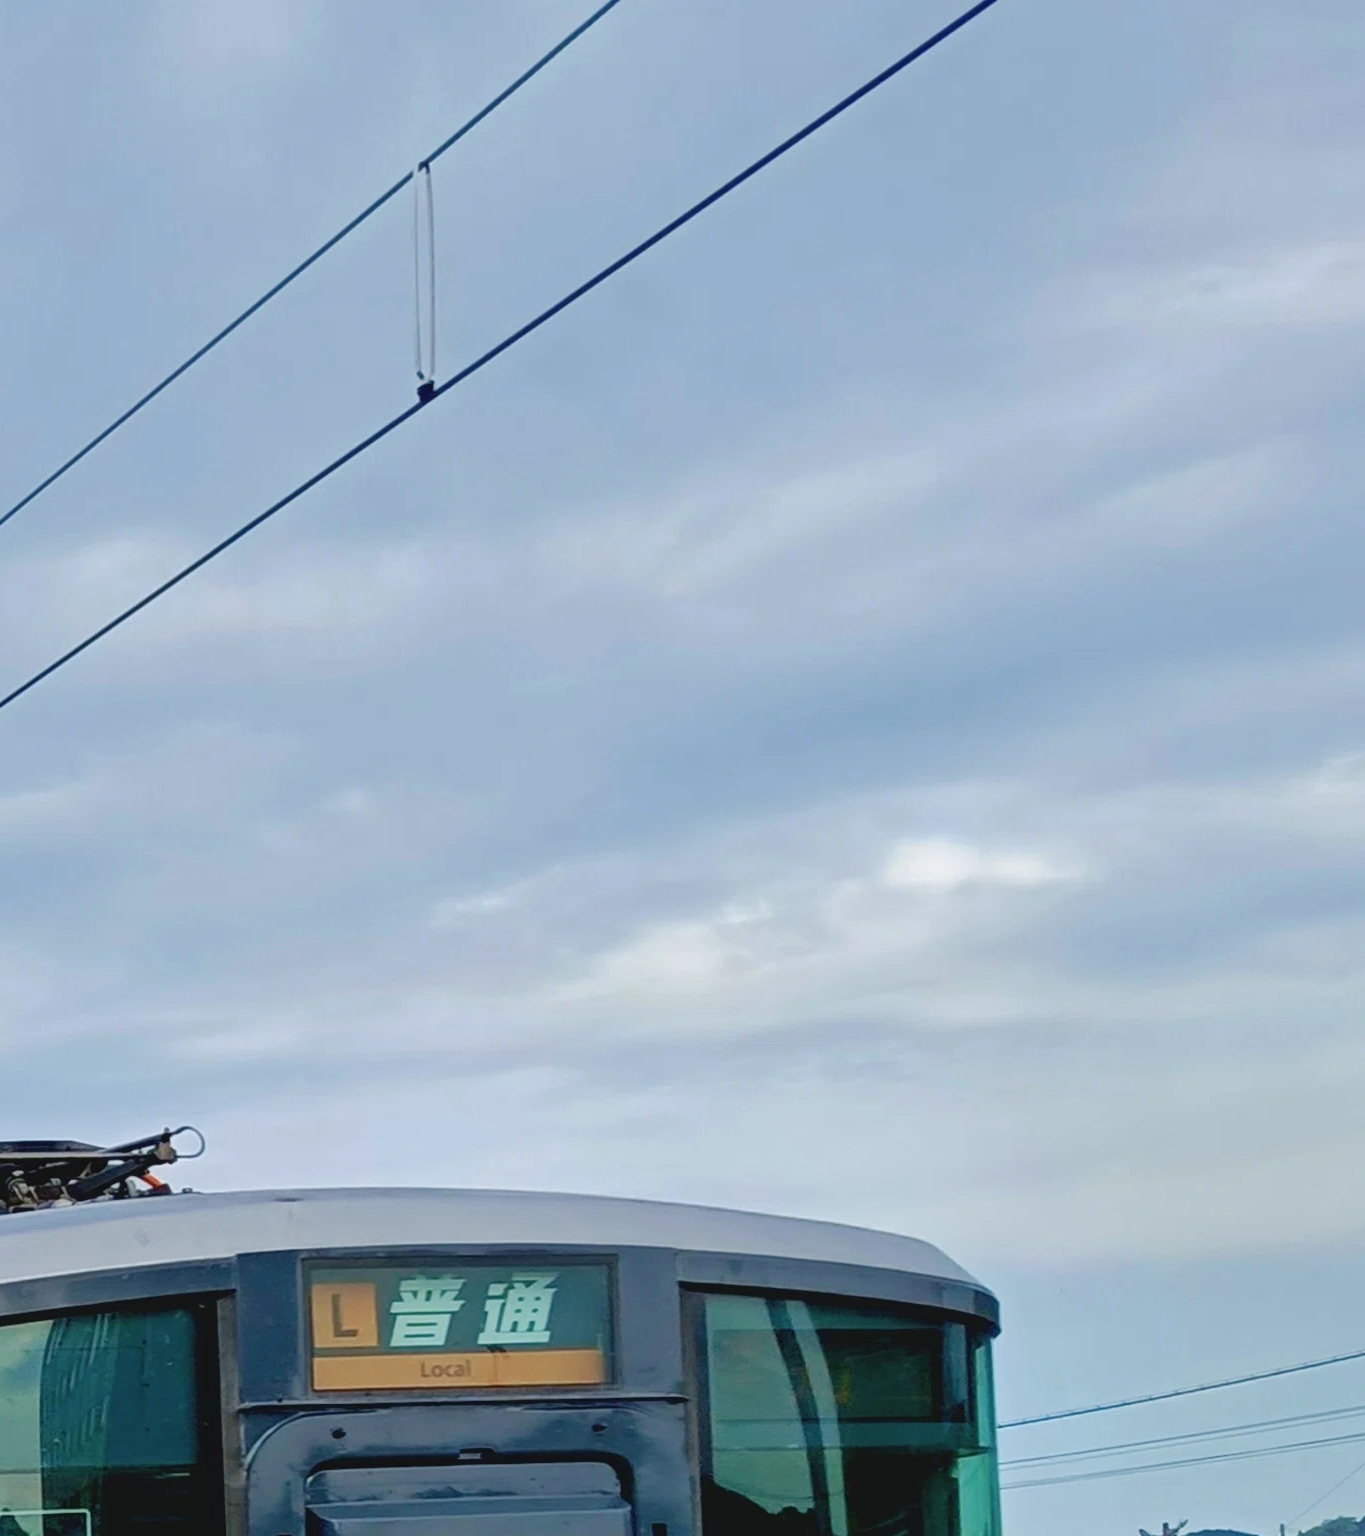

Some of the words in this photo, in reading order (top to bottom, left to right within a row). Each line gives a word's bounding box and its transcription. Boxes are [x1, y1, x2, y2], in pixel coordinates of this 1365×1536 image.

[331, 1293, 359, 1338] L
[389, 1271, 561, 1347] 普通
[420, 1359, 472, 1378] Local
